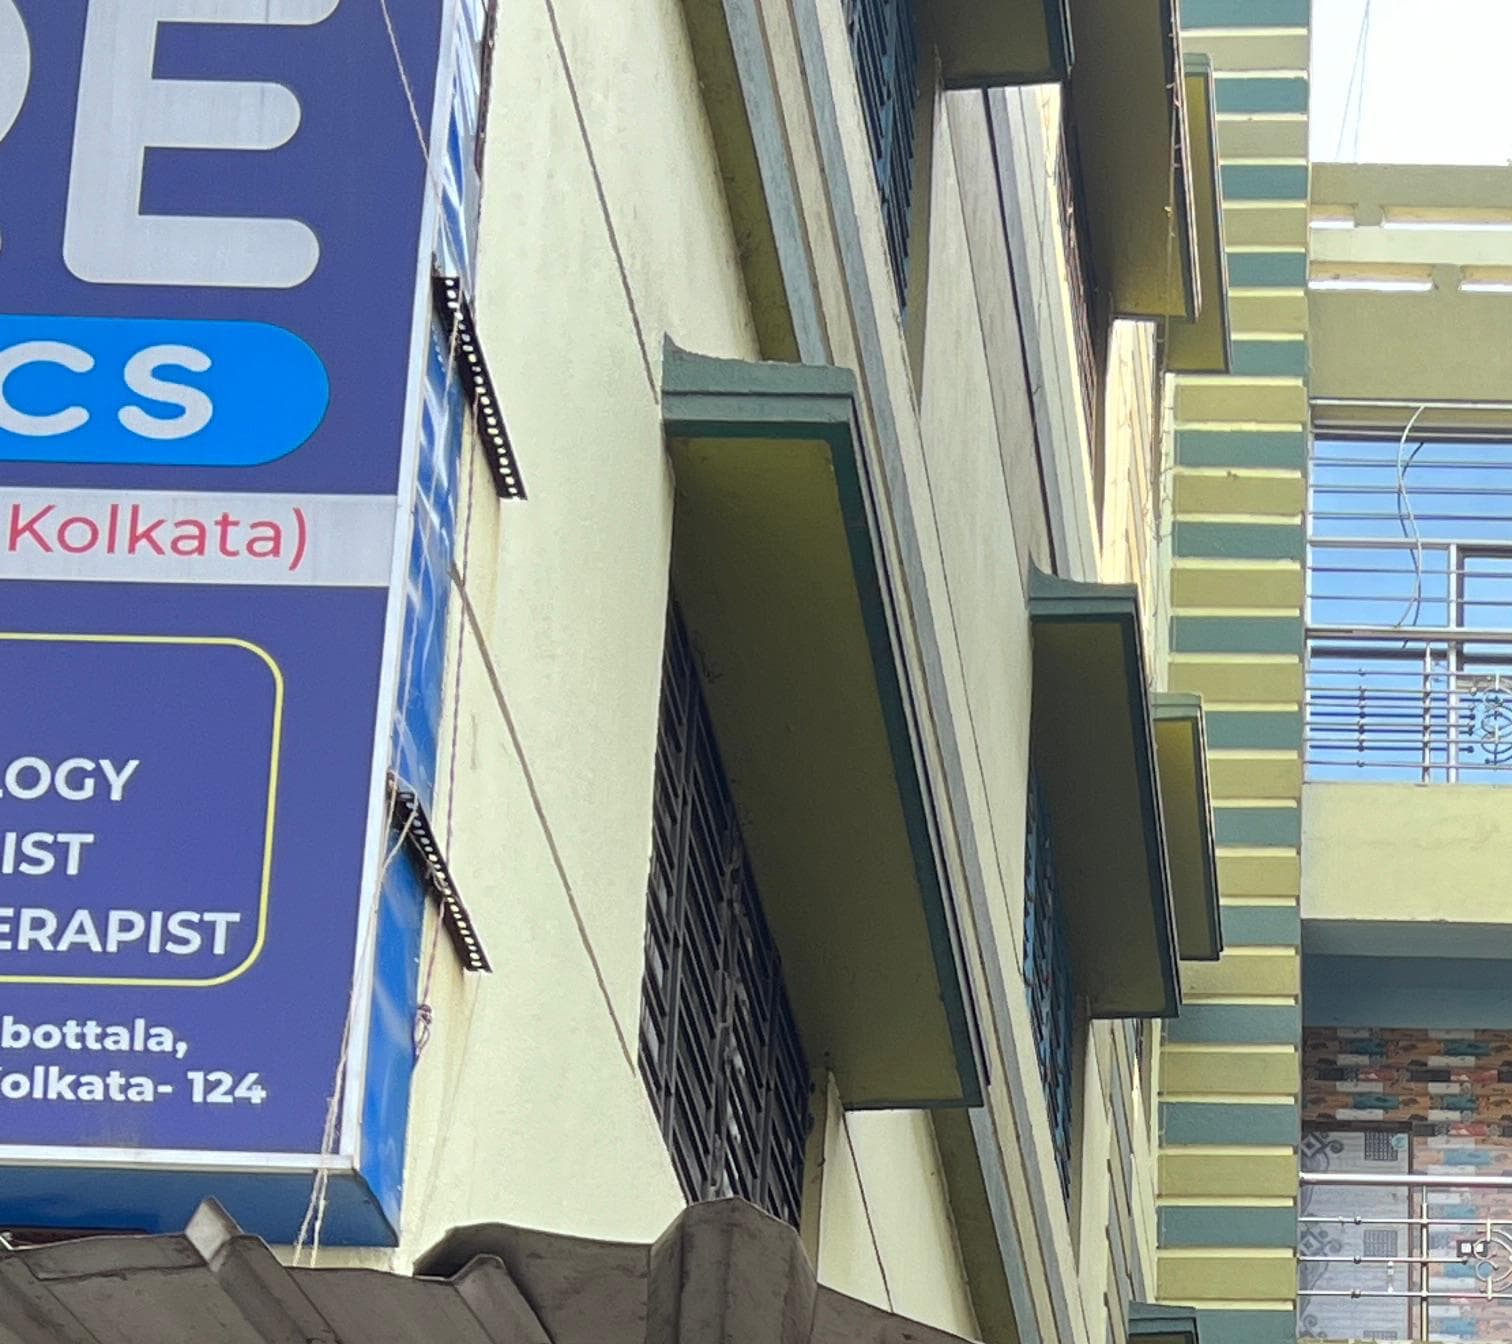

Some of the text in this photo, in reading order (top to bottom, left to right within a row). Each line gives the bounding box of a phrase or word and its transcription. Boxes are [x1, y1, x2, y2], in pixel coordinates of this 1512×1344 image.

[0, 0, 340, 289] E
[1, 340, 213, 441] CS
[8, 502, 310, 572] Kolkata)
[0, 757, 139, 801] OGY
[0, 1065, 267, 1104] olkata- 124
